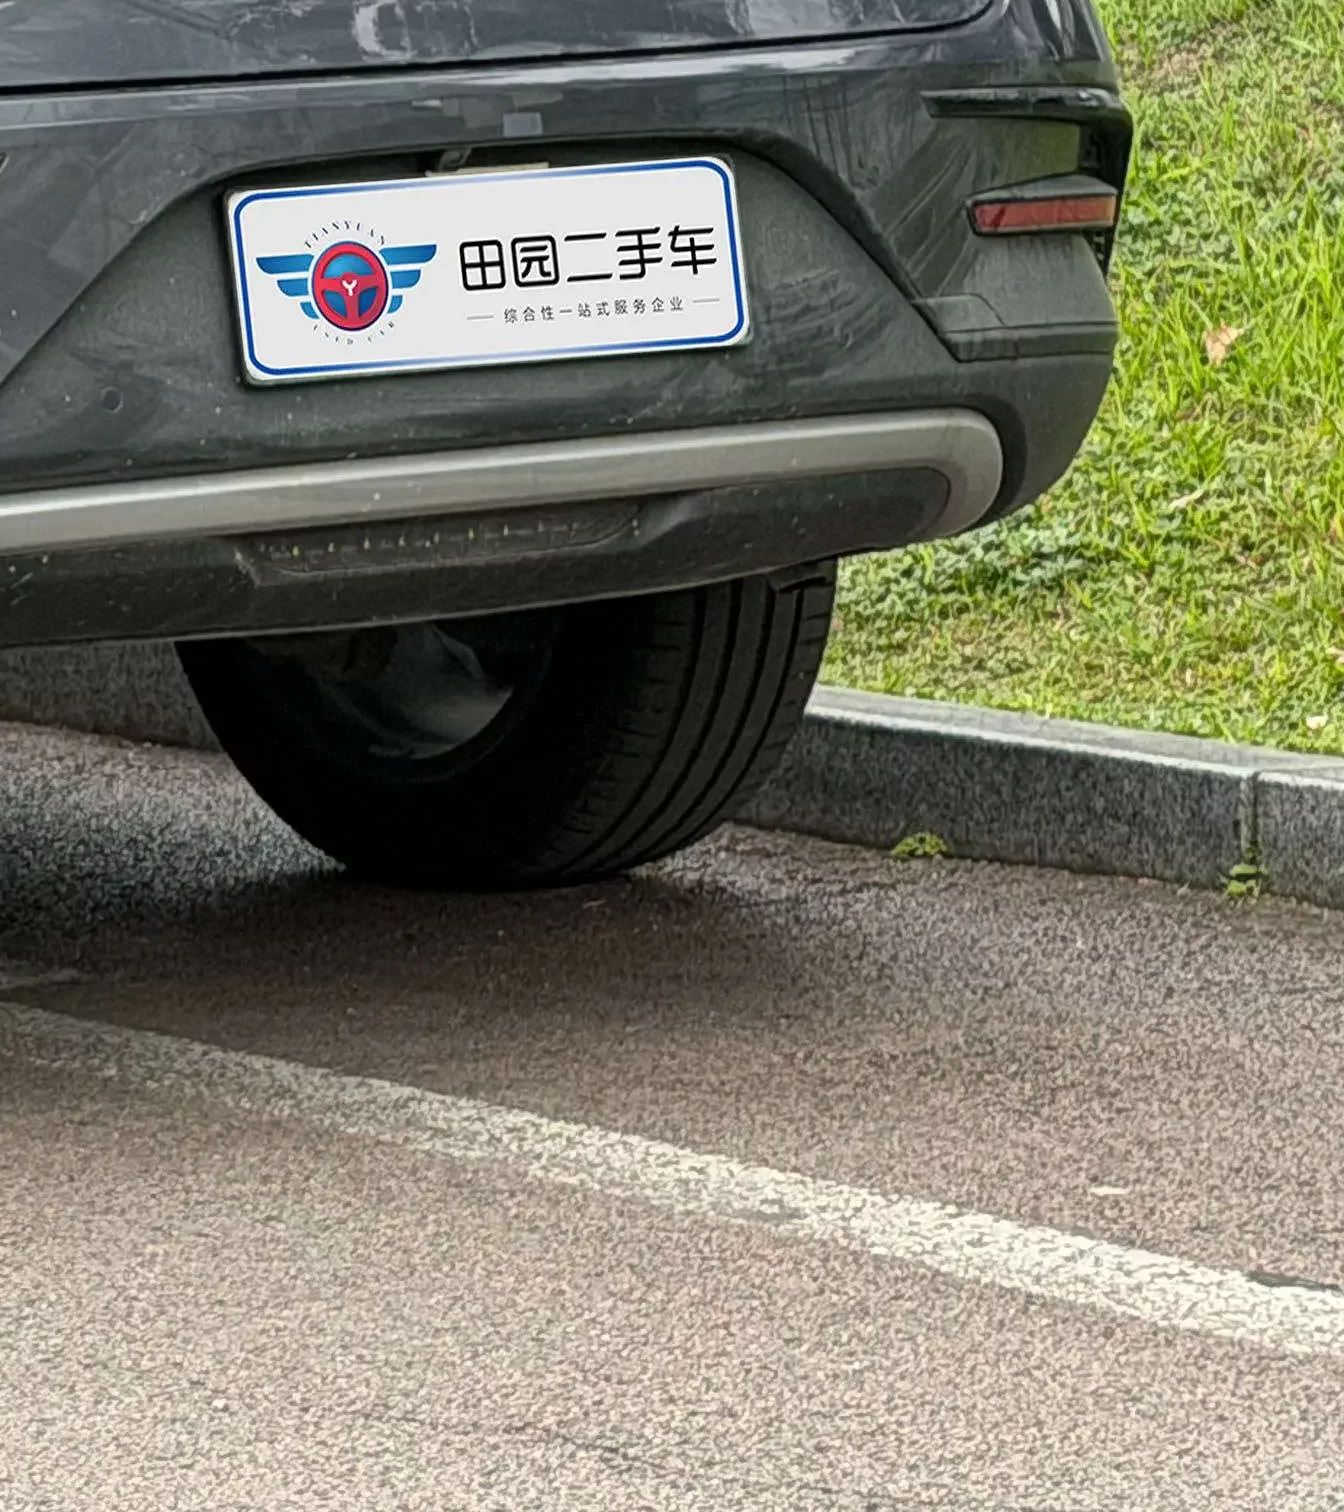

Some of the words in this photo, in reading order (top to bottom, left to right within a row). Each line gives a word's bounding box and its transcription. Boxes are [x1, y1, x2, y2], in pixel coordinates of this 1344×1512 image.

[459, 225, 718, 292] 田园二手车
[503, 295, 684, 324] 综合性一站式服务企业
